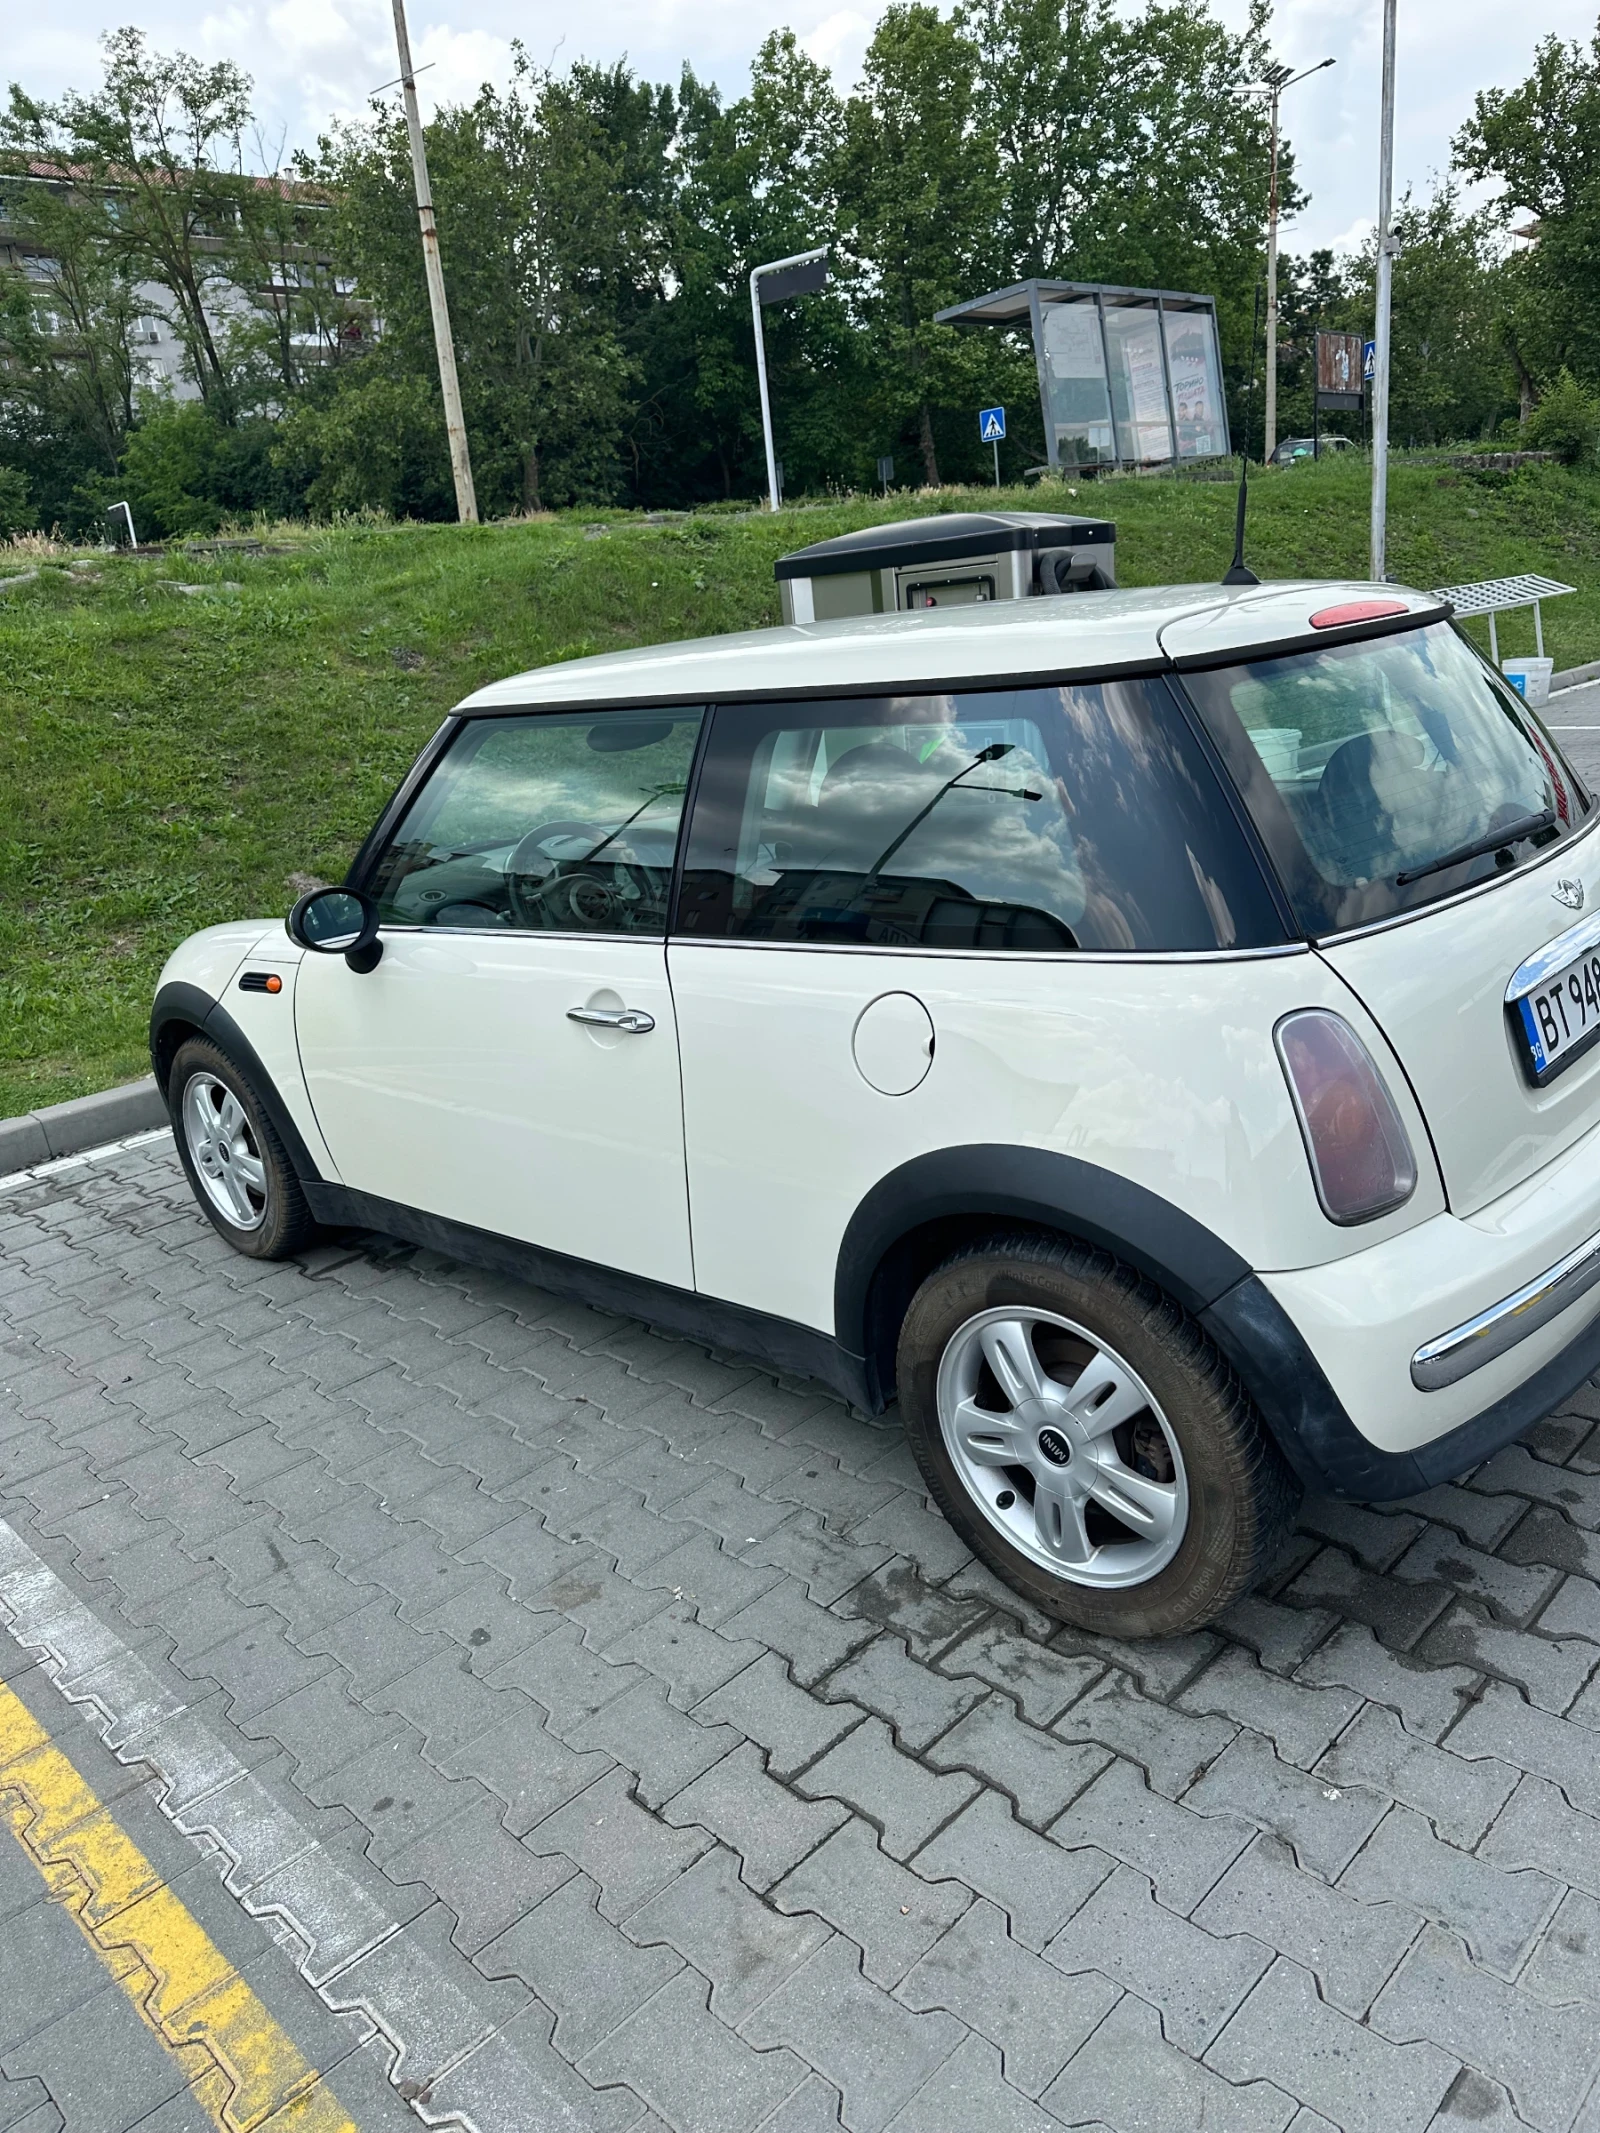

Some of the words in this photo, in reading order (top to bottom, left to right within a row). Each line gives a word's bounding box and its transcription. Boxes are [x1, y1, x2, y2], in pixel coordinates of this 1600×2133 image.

[1535, 982, 1570, 1053] BT
[1041, 1433, 1066, 1461] MINI
[1188, 1566, 1216, 1601] 185/60
